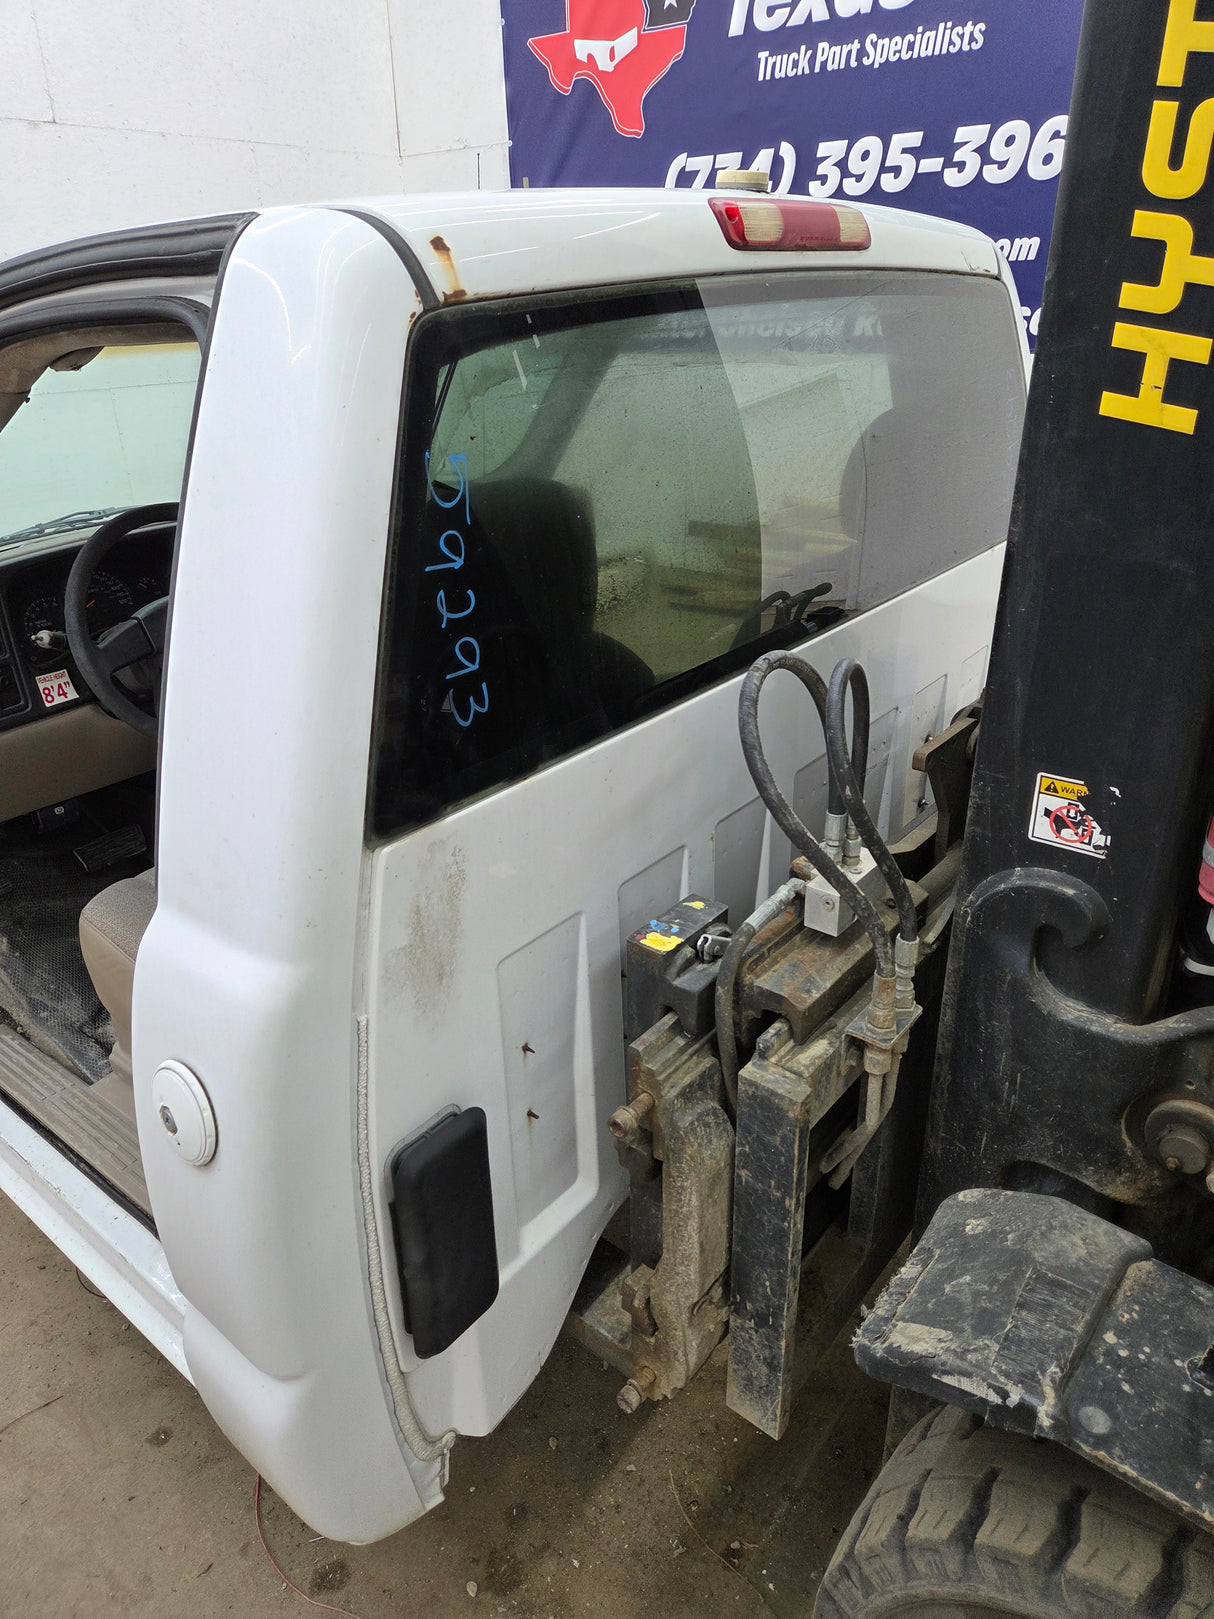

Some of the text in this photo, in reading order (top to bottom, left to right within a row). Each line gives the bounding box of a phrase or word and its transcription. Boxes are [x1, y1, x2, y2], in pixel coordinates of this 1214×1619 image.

[728, 0, 915, 37] Tex
[757, 20, 986, 82] Truck Part Specialists
